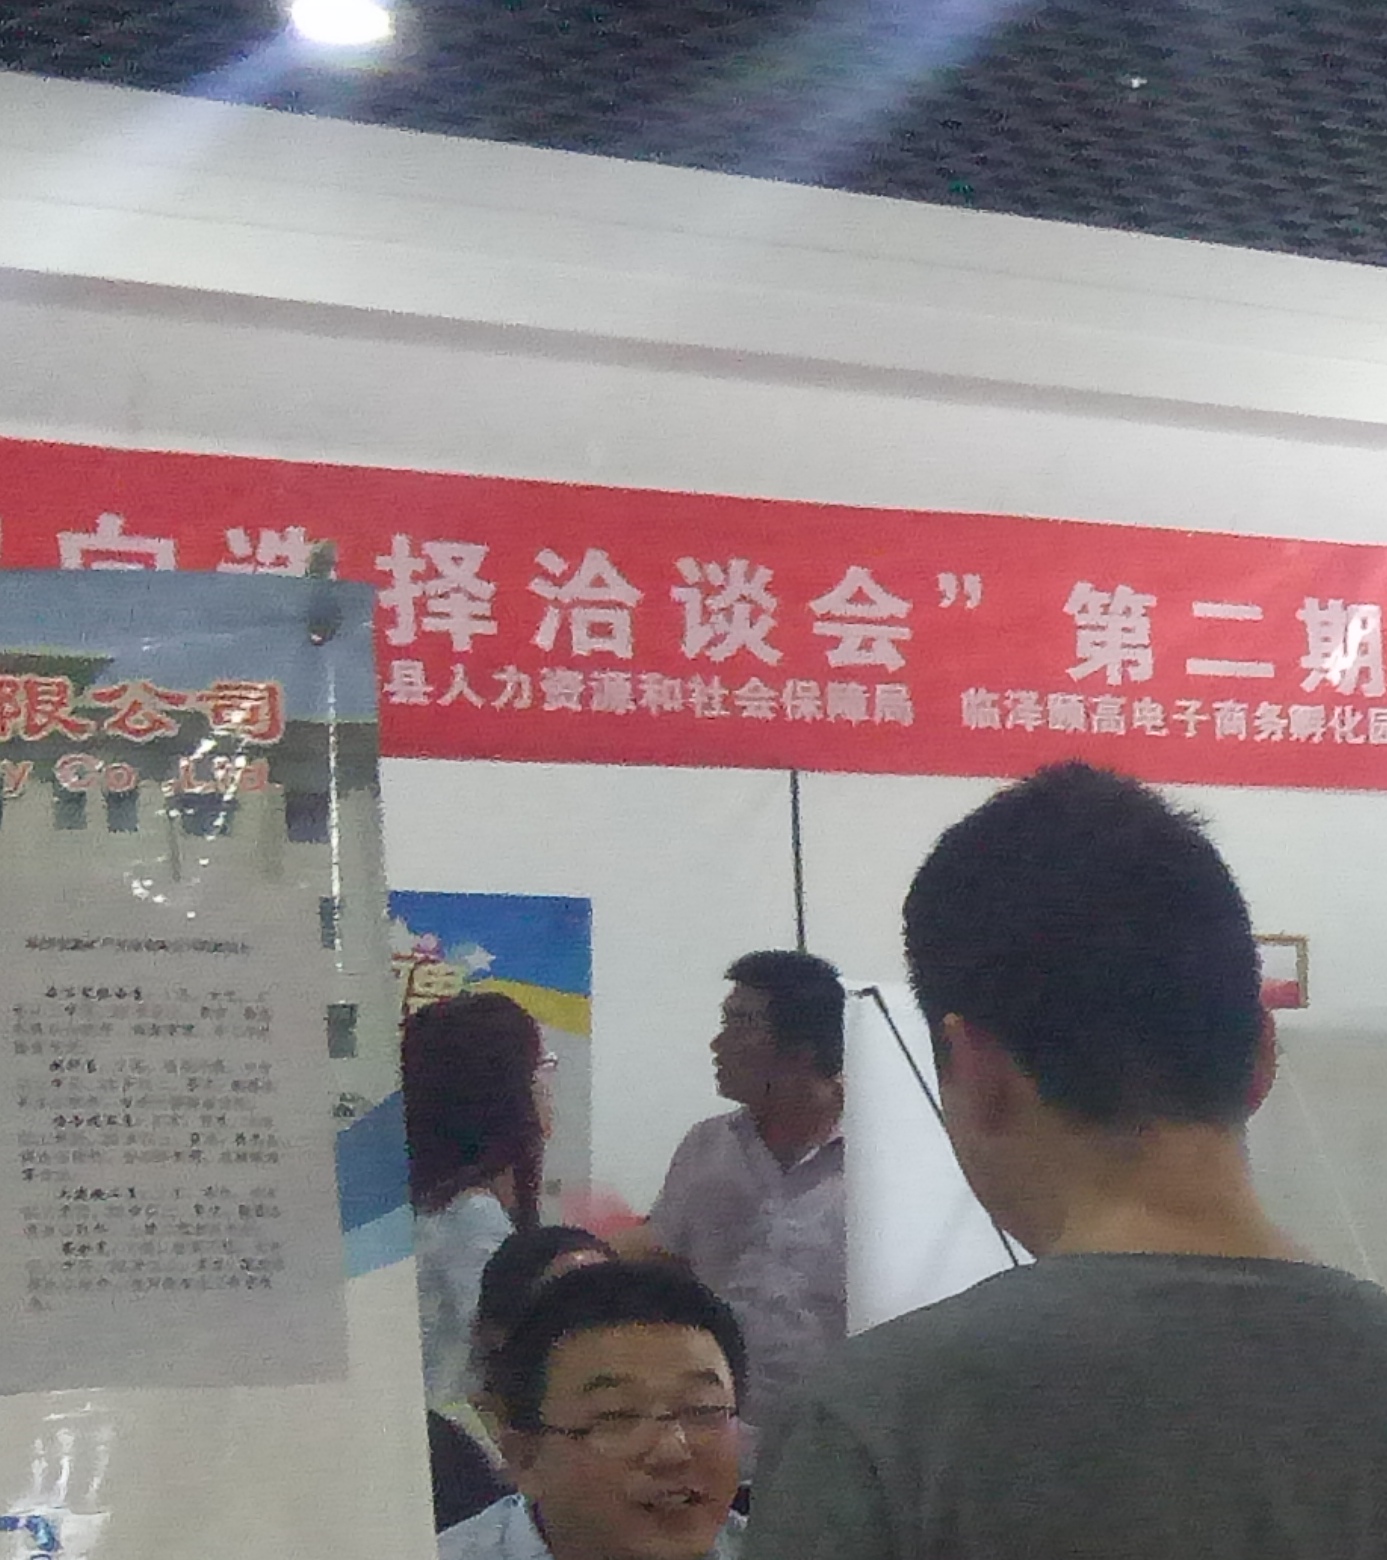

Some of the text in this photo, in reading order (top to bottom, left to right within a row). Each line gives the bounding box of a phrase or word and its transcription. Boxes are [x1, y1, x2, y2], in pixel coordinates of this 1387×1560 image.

[1062, 580, 1387, 697] 第二期
[383, 658, 915, 728] 县人力资源和社会保障局
